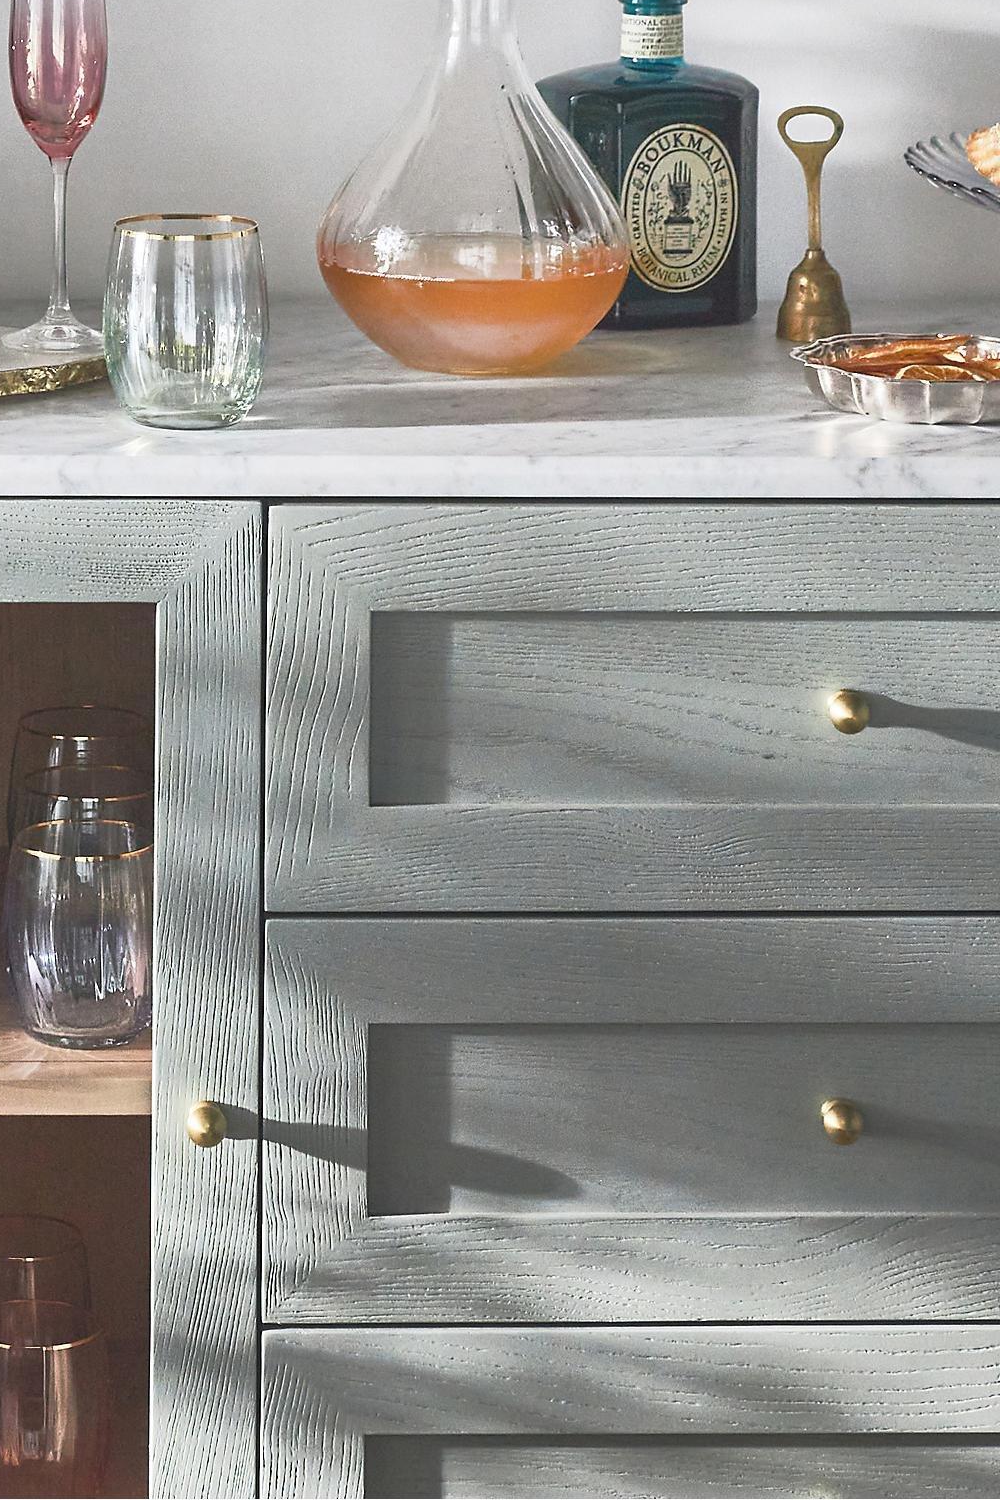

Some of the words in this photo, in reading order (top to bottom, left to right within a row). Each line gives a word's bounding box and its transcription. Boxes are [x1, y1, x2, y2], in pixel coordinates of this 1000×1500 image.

[637, 132, 726, 175] BOUKMAN
[633, 191, 642, 241] CRAFTED
[719, 191, 728, 204] IN
[716, 207, 728, 241] HAITI
[637, 244, 690, 284] BOTANICAL
[690, 244, 720, 279] RHUM
